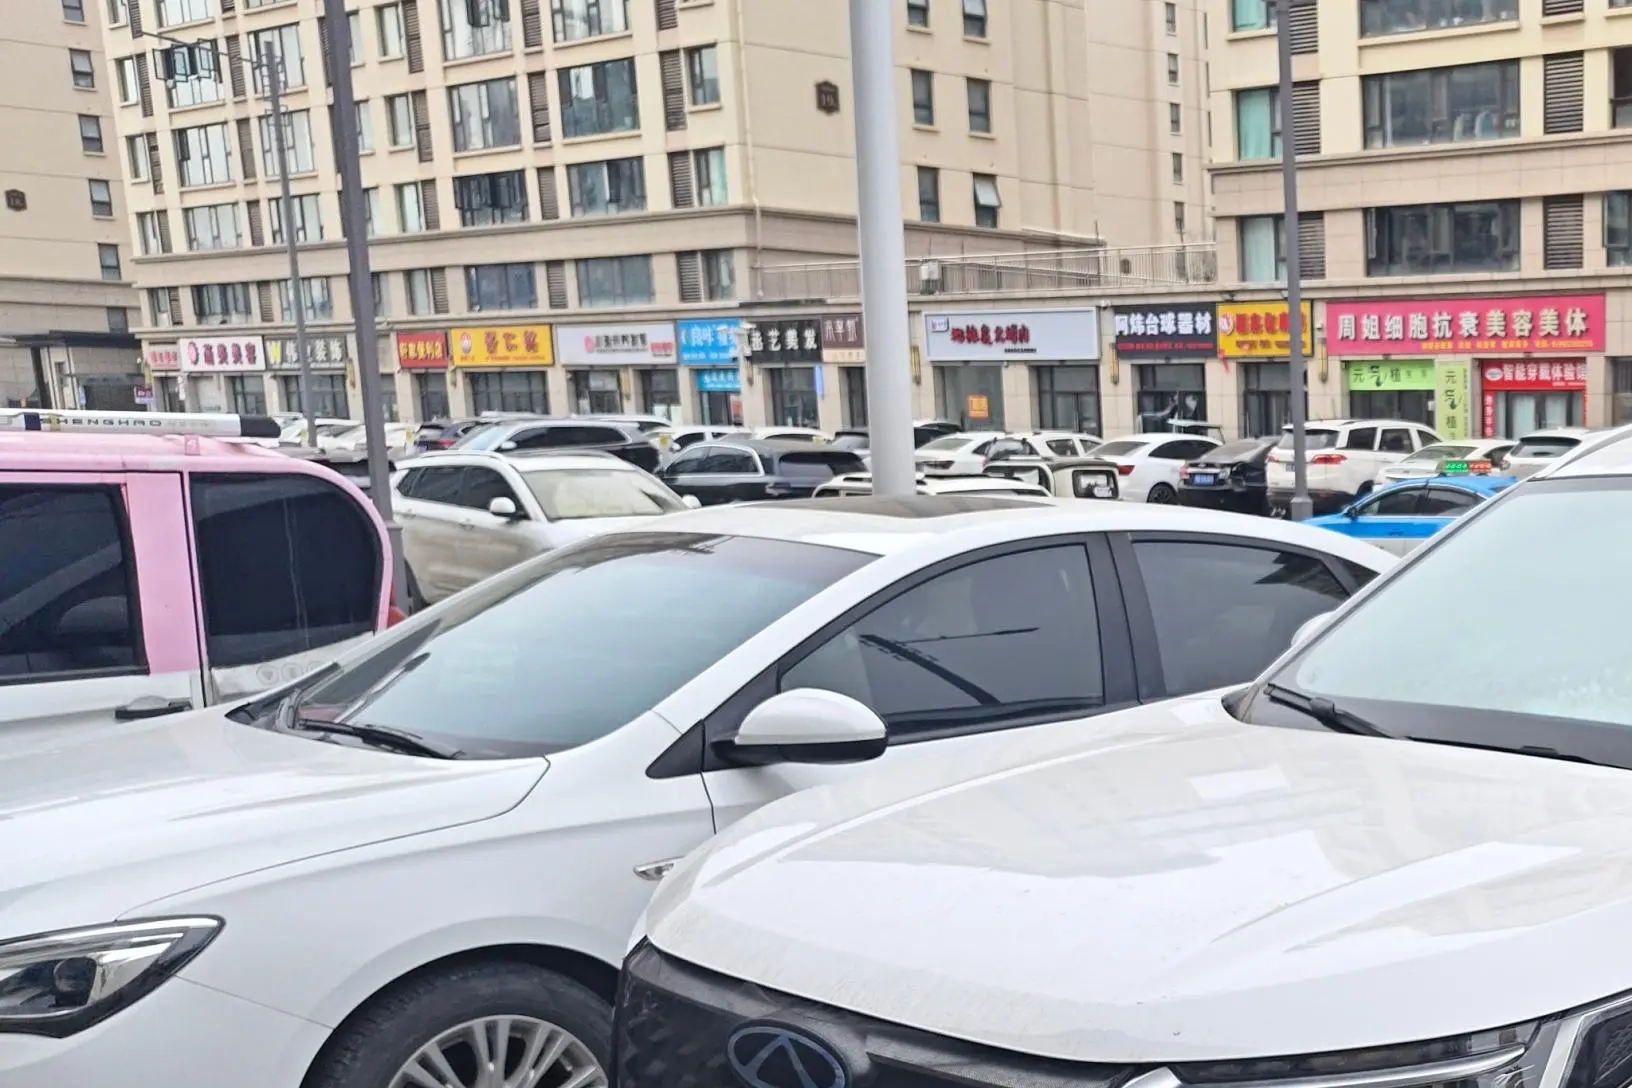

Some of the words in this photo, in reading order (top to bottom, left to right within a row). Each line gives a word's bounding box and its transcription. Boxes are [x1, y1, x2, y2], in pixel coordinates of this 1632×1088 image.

[1114, 312, 1212, 336] 阿炜台球器材
[1338, 308, 1588, 341] 周姐细胞抗衰美容美体
